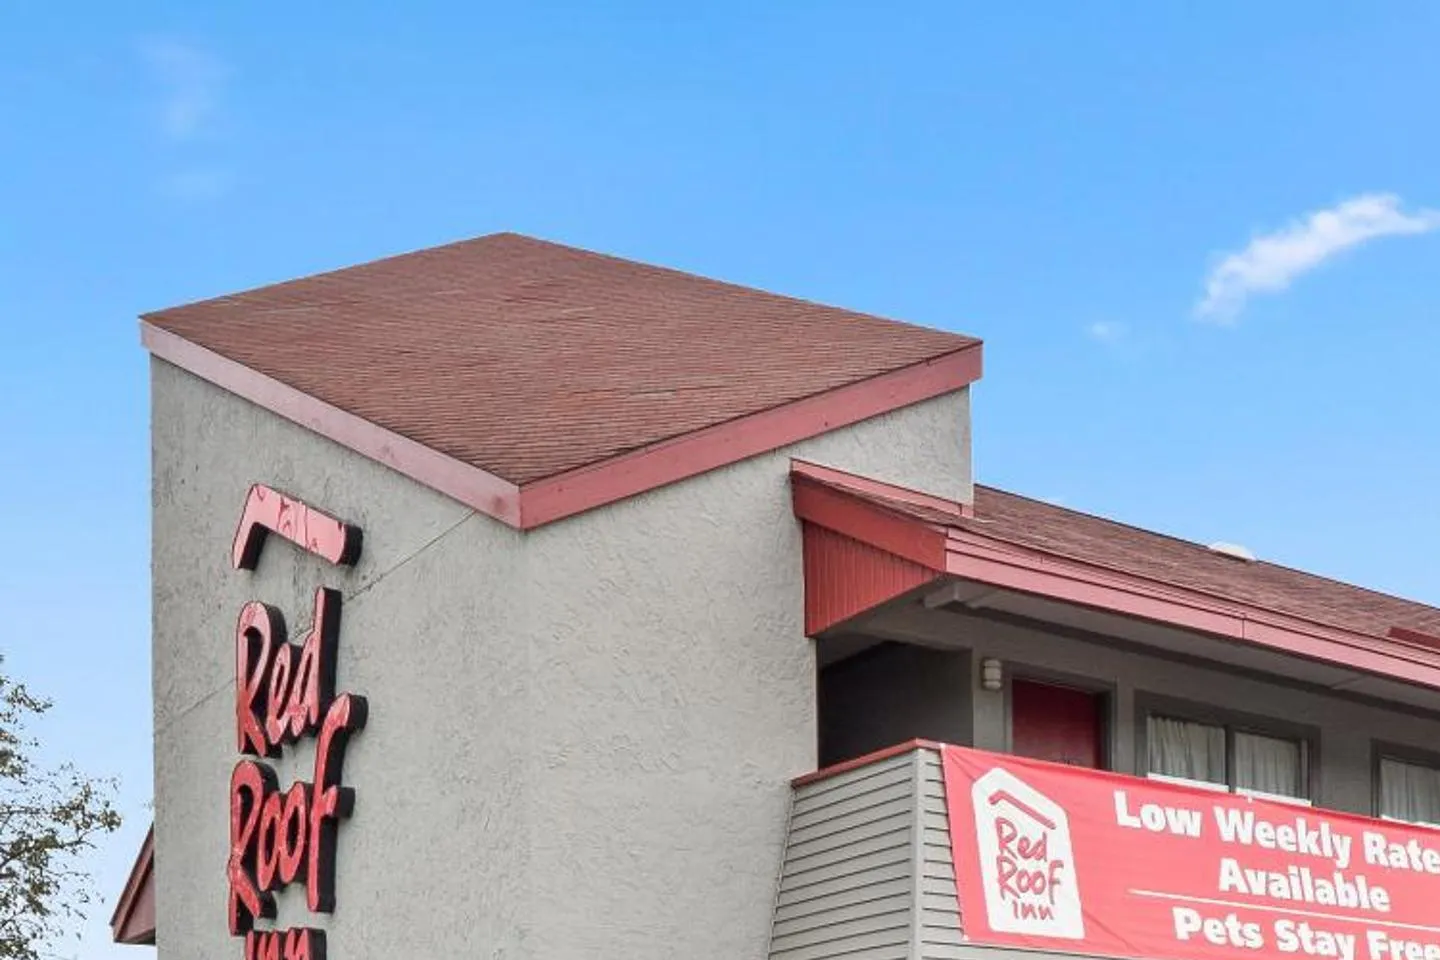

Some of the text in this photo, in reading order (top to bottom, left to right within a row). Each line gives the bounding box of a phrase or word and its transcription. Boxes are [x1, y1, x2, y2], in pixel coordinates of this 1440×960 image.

[236, 585, 342, 758] Red
[227, 692, 368, 937] Roof
[994, 816, 1048, 862] Red
[1113, 790, 1202, 840] Low
[1213, 805, 1352, 869] Weekly
[996, 855, 1065, 905] Roof
[1218, 857, 1392, 913] Available
[1172, 907, 1265, 949] Pets
